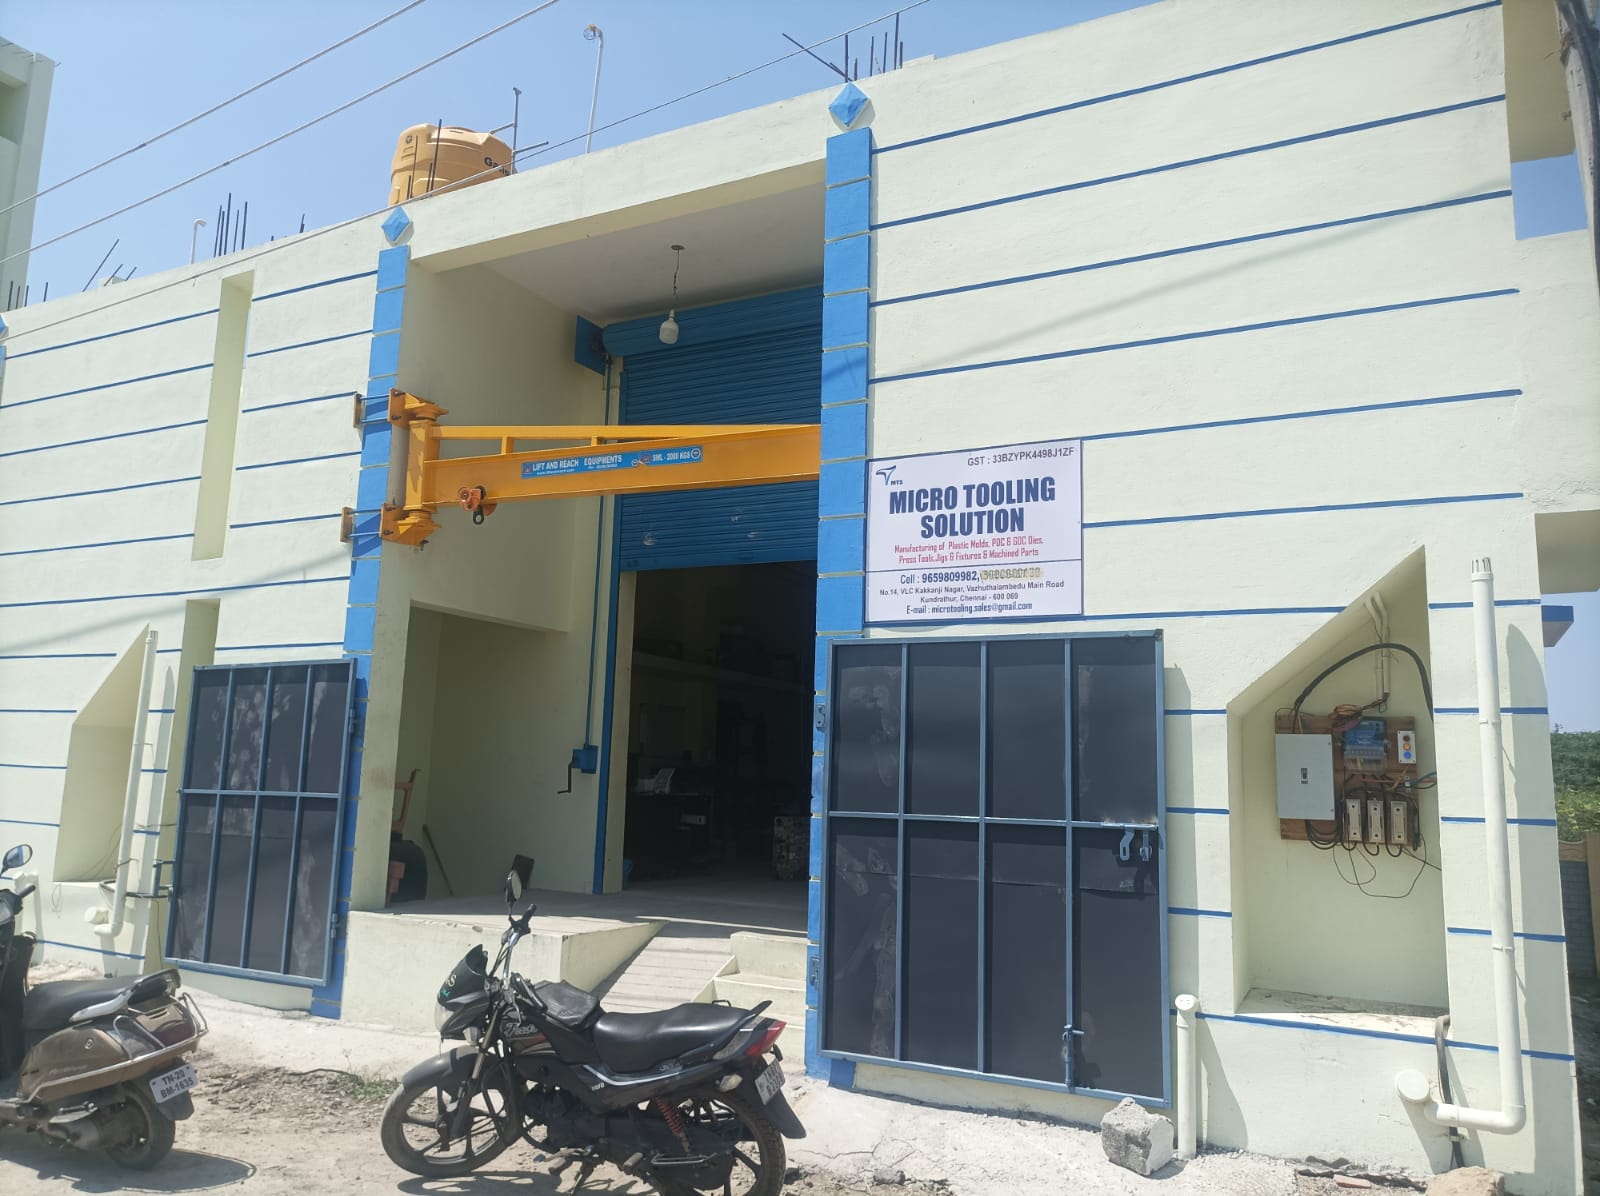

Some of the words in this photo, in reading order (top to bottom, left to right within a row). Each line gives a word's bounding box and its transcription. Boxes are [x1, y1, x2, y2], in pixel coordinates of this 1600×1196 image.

[533, 463, 545, 471] LIFT
[546, 461, 558, 470] AND
[560, 458, 579, 468] REACH
[584, 454, 622, 466] EQUIPMENTS
[967, 456, 985, 467] GST
[992, 447, 1075, 464] 33BZYPK4498J1ZF
[889, 486, 958, 514] MICRO
[963, 476, 1056, 508] TOOLING
[921, 507, 1024, 539] SOLUTION
[894, 544, 937, 553] Manufacturing
[938, 541, 945, 550] of
[948, 541, 969, 550] Plastic
[1007, 537, 1011, 546] &
[899, 555, 916, 564] Press
[949, 552, 954, 561] &
[956, 551, 981, 561] Fixtures
[983, 550, 987, 559] &
[989, 548, 1019, 558] Machined
[1020, 547, 1039, 557] Parts
[900, 574, 915, 584] Cell
[921, 571, 979, 584] 9659809982,
[901, 587, 914, 595] VLC
[915, 586, 942, 595] Kakkanji
[944, 585, 965, 594] Nagar,
[1028, 581, 1044, 589] Main
[1045, 580, 1065, 588] Road
[960, 594, 987, 602] Chennai
[993, 593, 1004, 601] 600
[906, 605, 927, 614] E-mail
[931, 601, 1033, 614] microtooling.sales@gmail.com
